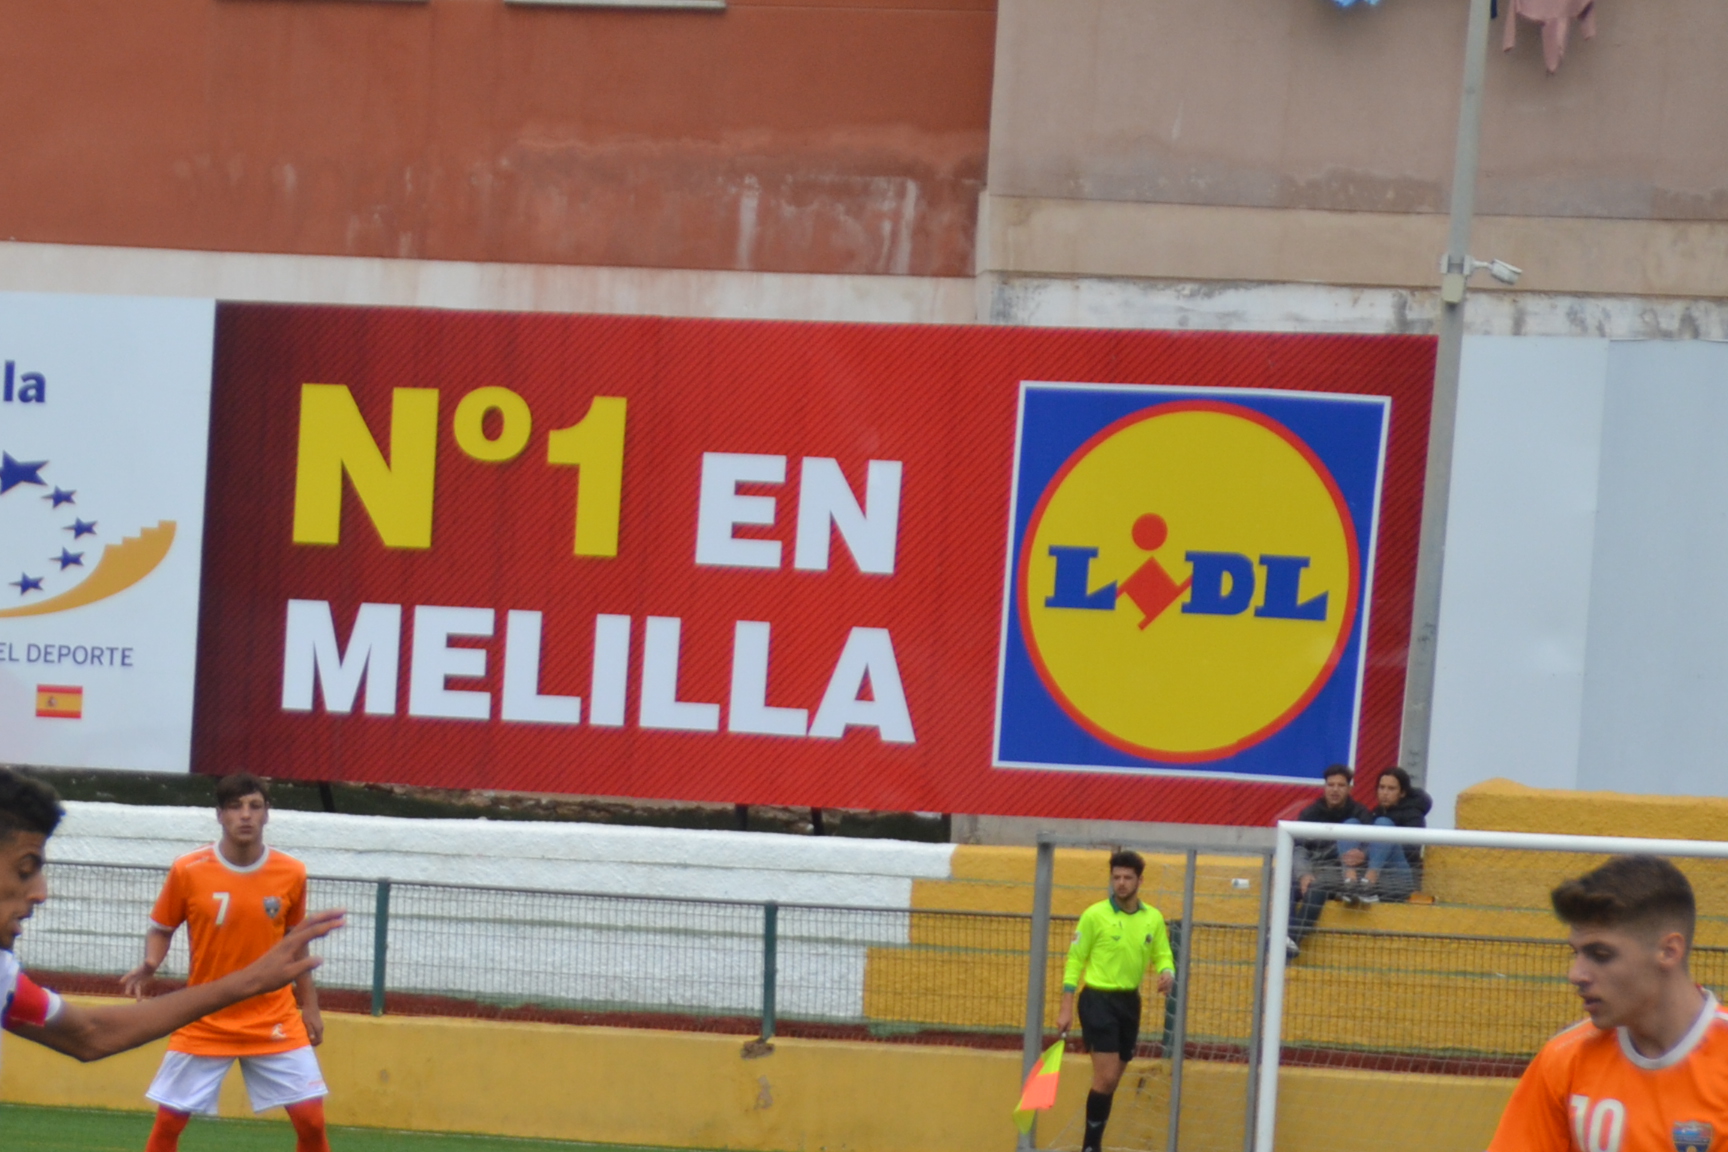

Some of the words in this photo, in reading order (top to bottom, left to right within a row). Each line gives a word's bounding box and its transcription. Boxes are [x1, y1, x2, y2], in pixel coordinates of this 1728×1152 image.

[694, 450, 904, 575] EN
[26, 643, 135, 667] DEPORTE
[281, 598, 917, 744] MELILLA
[212, 892, 230, 926] 7
